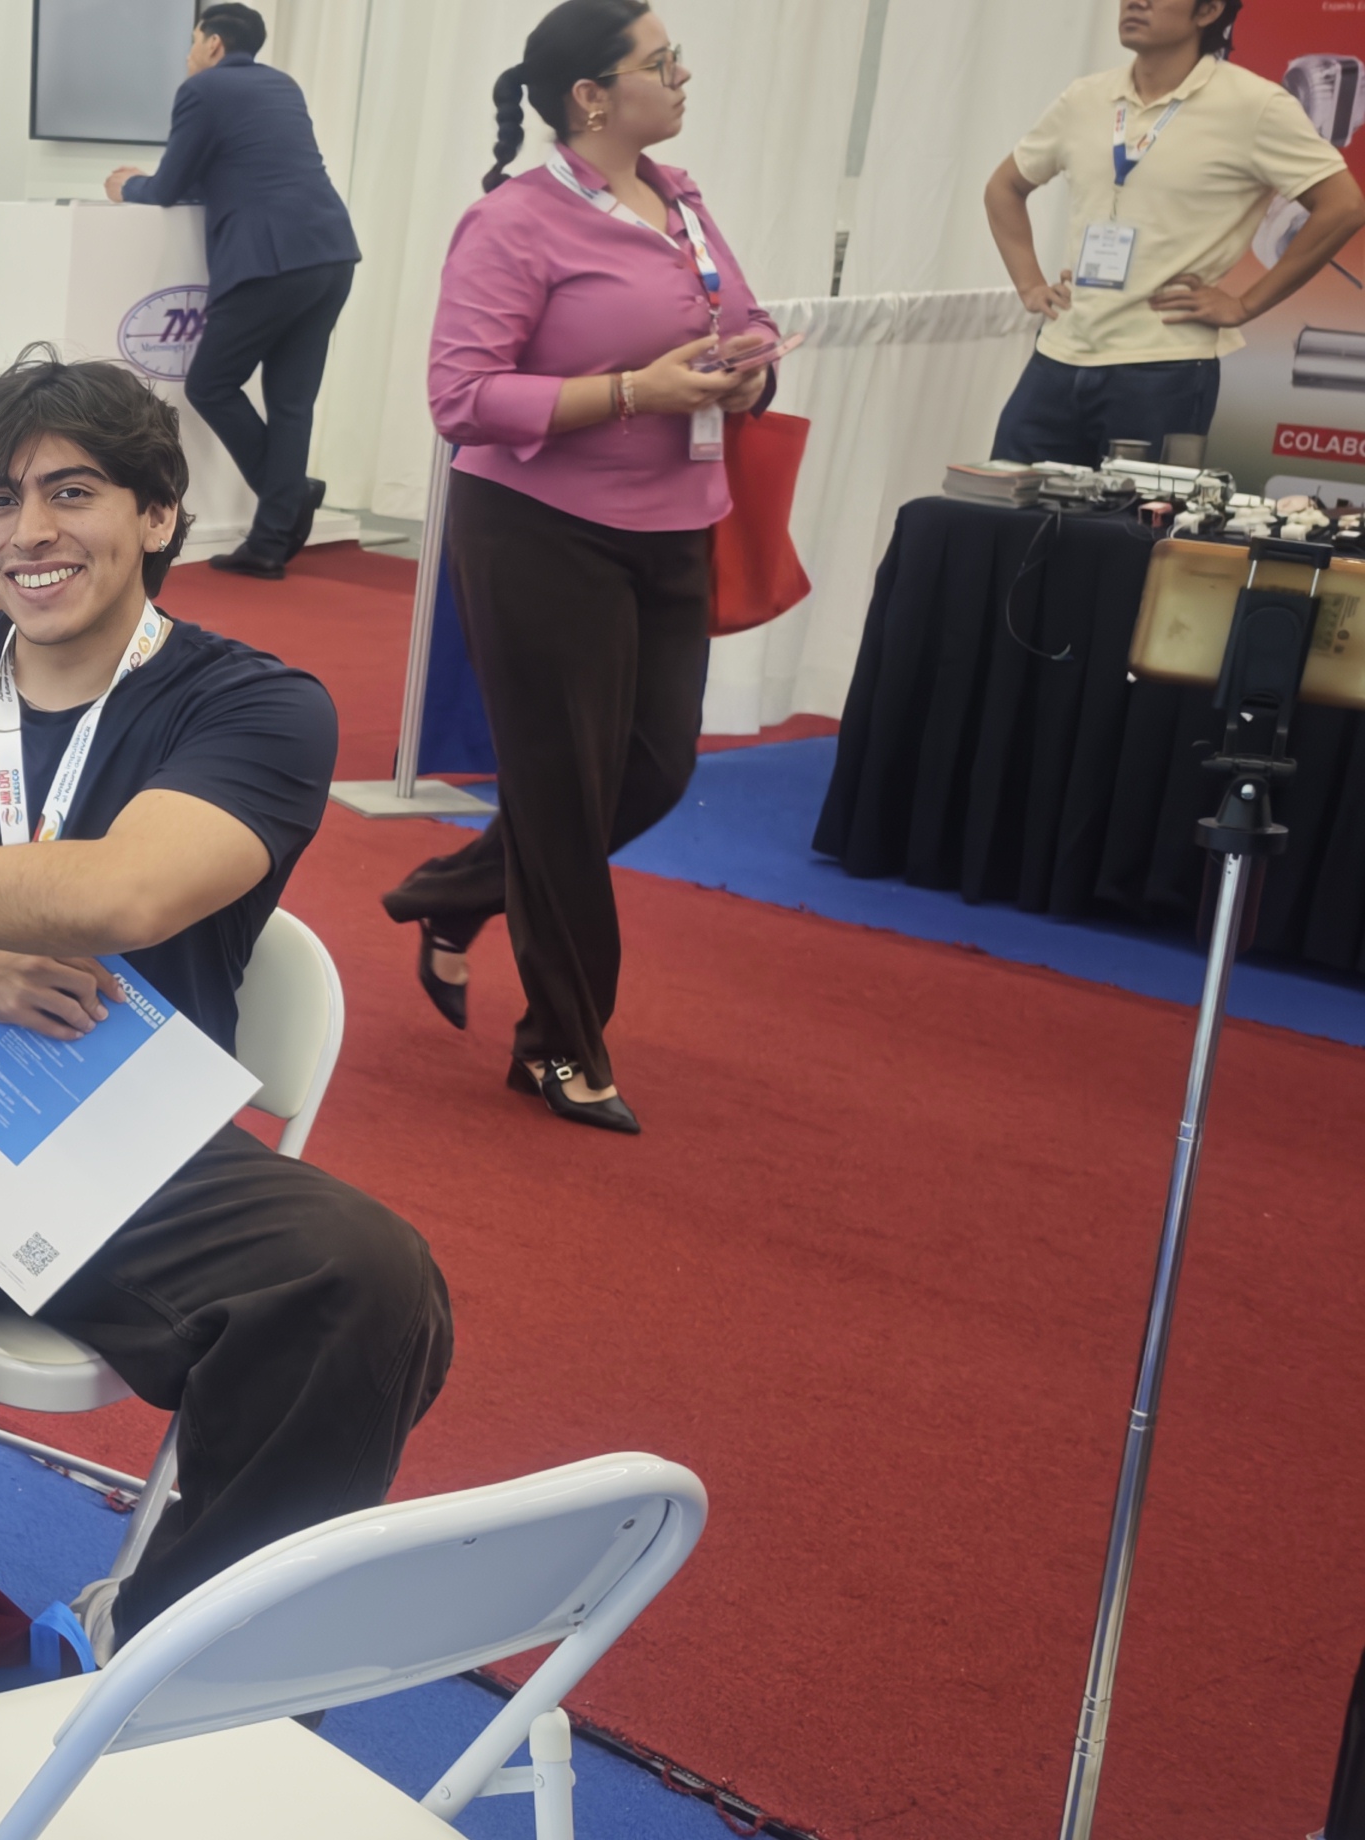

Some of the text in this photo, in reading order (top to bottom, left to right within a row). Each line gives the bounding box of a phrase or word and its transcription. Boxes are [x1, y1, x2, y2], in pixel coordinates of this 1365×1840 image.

[64, 769, 77, 794] futuro
[74, 755, 82, 769] del
[79, 725, 91, 755] HVACR
[53, 770, 70, 802] Juntos,
